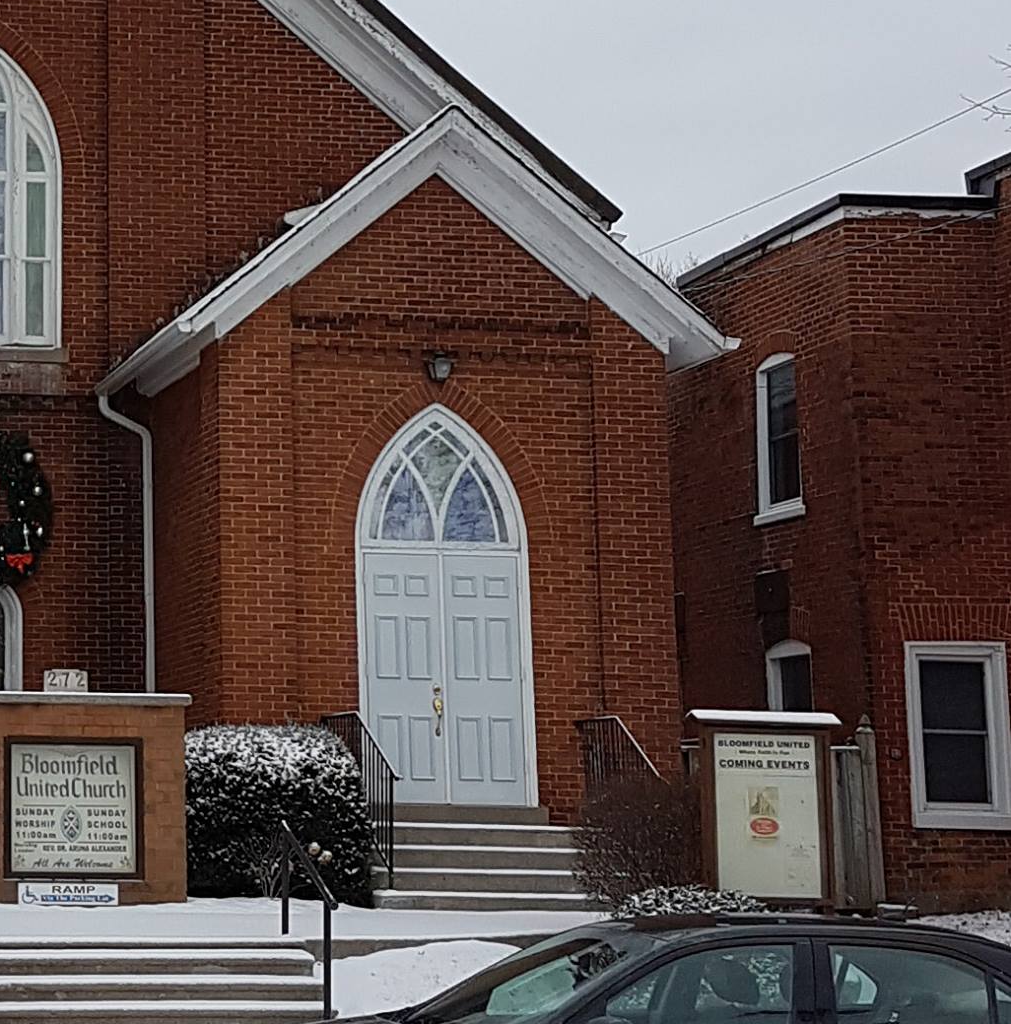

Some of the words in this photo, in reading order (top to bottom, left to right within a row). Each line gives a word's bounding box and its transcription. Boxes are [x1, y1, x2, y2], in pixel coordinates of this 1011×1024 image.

[47, 672, 85, 688] 272
[717, 739, 774, 748] BLOOMFIELD
[776, 740, 810, 749] UNITED
[21, 752, 118, 776] Bloomfield
[719, 759, 763, 768] COMING
[767, 760, 810, 769] EVENTS
[16, 776, 69, 798] United
[71, 777, 126, 799] Church
[15, 808, 55, 816] SUNDAY
[87, 809, 126, 817] SUNDAY
[15, 820, 56, 828] WORSHIP
[87, 821, 127, 829] SCHOOL
[16, 831, 57, 839] 11:00am
[88, 833, 128, 841] 11:00am
[51, 885, 96, 894] RAMP
